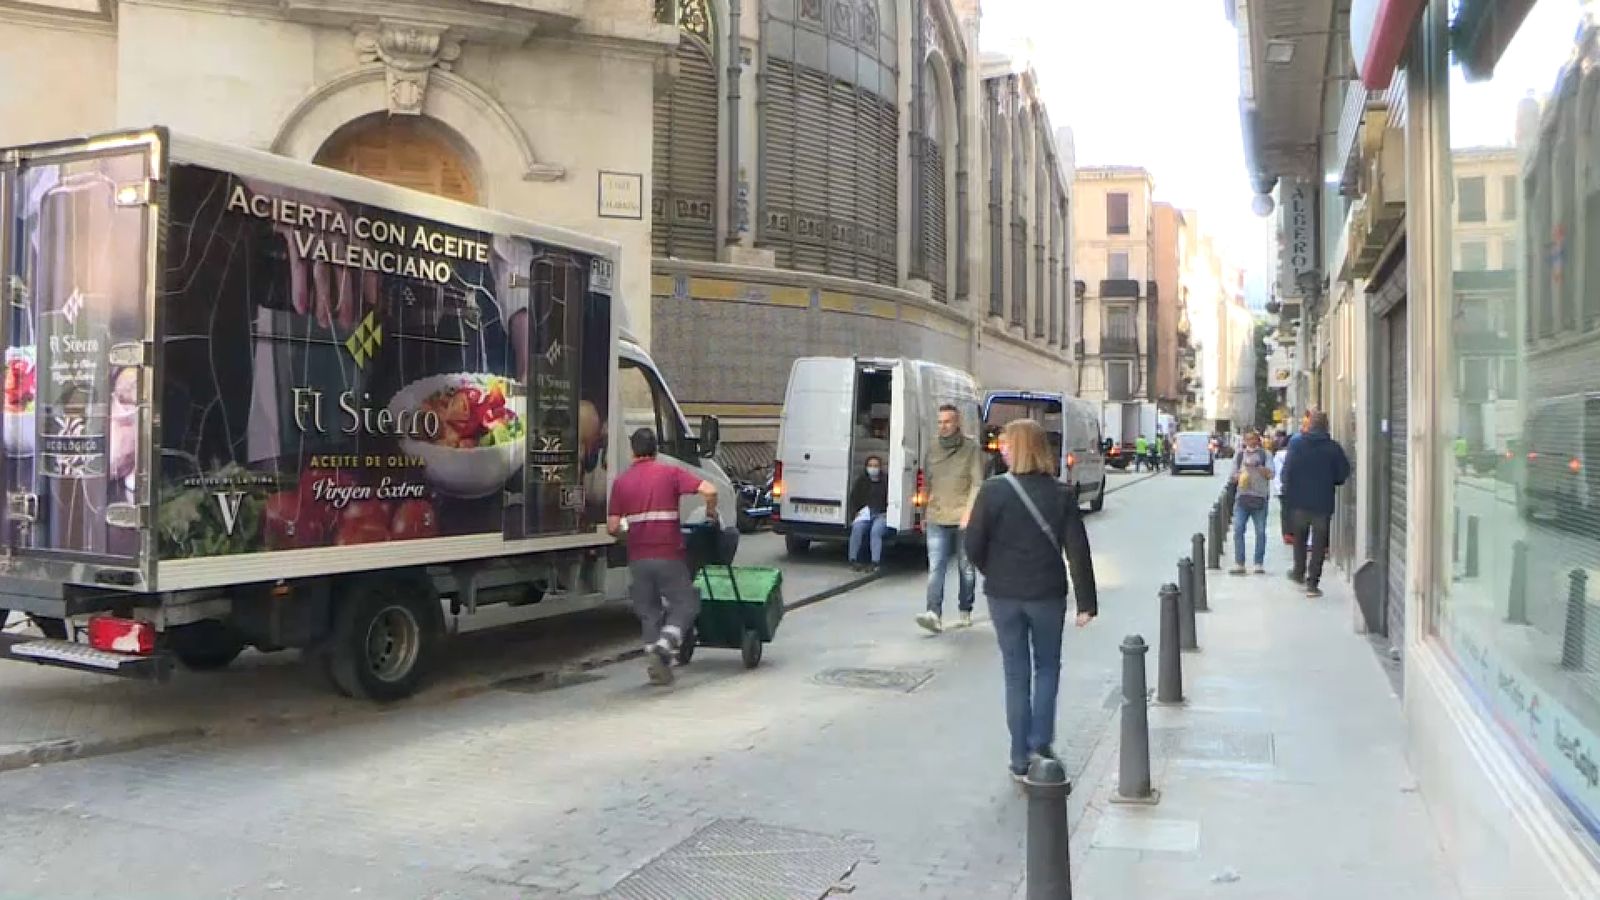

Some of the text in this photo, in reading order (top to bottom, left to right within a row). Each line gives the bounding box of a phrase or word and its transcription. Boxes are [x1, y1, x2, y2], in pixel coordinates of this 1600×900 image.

[228, 184, 489, 263] ACIERTA CON ACEITE
[294, 229, 451, 283] VALENCIANO
[338, 390, 440, 438] Sierro
[310, 455, 426, 468] ACEITE DE OLIVA
[312, 476, 425, 508] Virgen Extra
